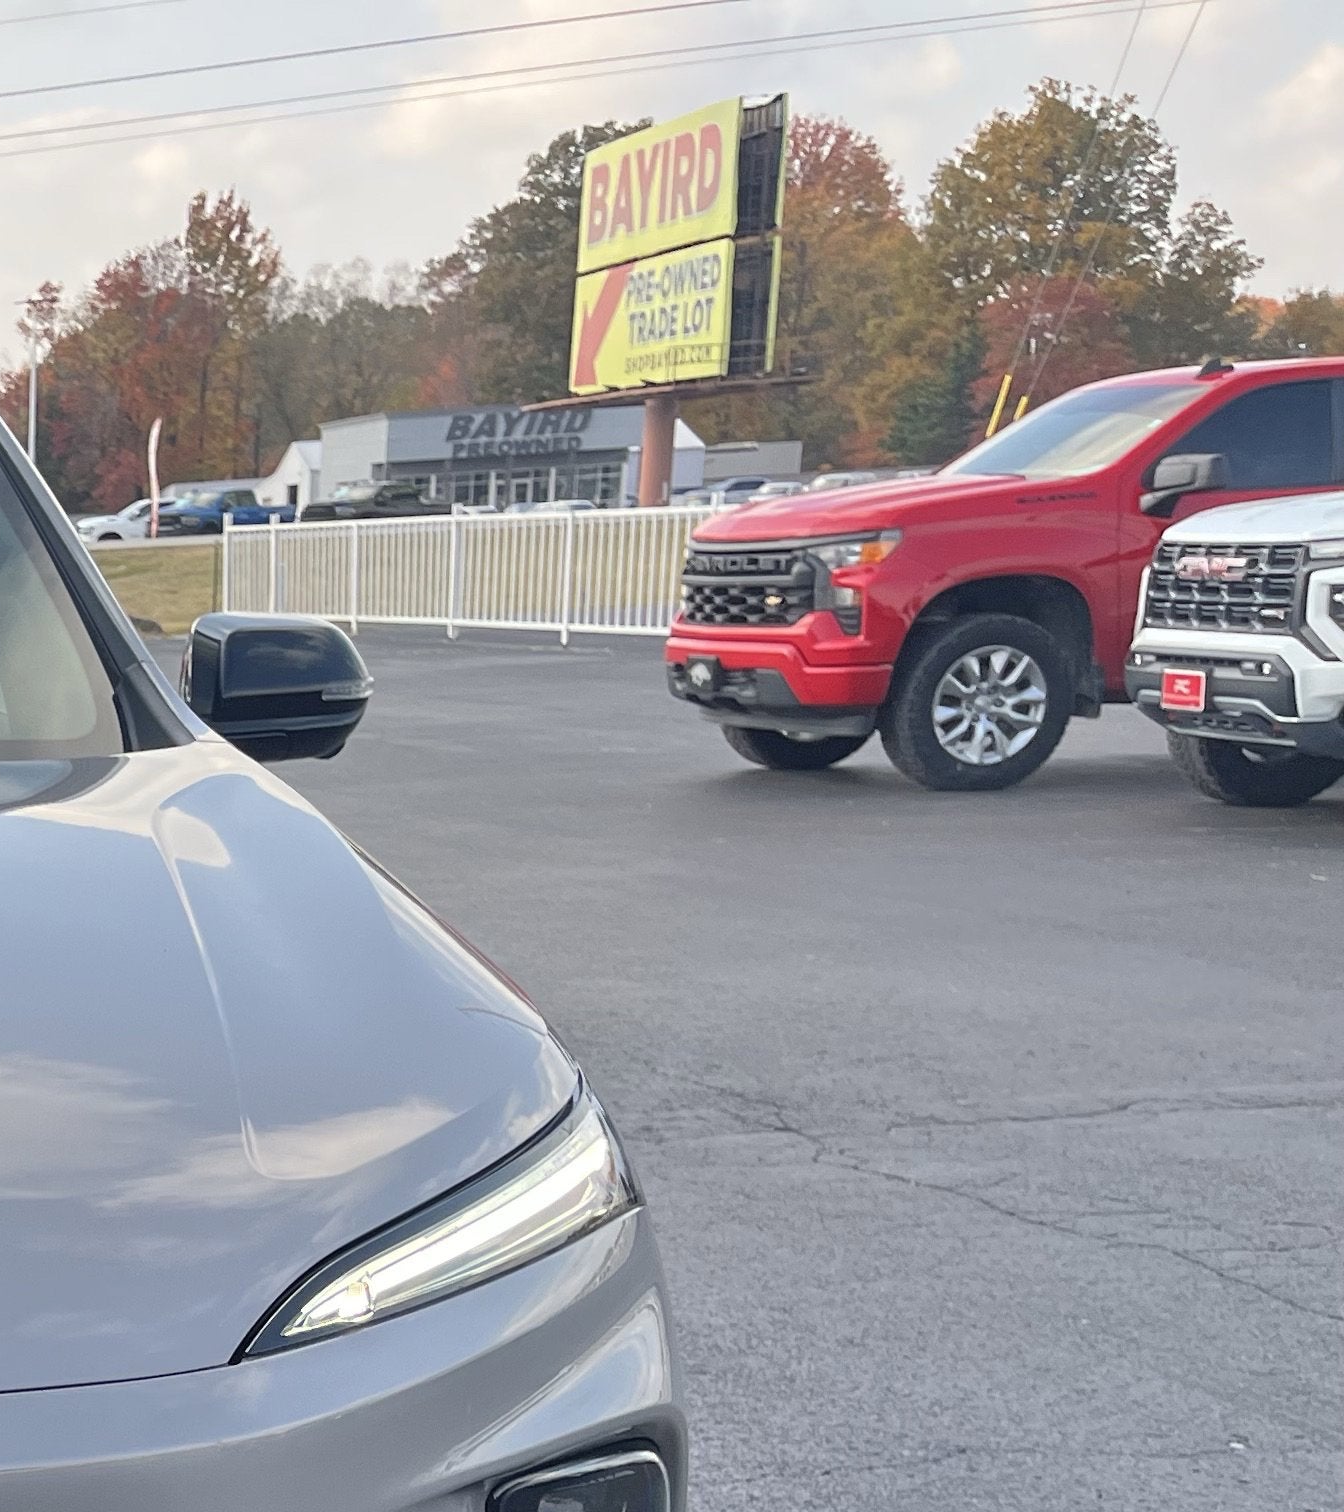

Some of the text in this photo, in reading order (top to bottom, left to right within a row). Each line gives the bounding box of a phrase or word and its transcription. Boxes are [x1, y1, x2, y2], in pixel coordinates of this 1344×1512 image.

[588, 123, 723, 245] BAYIRD
[626, 254, 722, 307] PRE-OWNED
[629, 297, 714, 346] TRADE LOT
[446, 407, 593, 442] BAYIRD
[452, 436, 583, 458] PREOWNED
